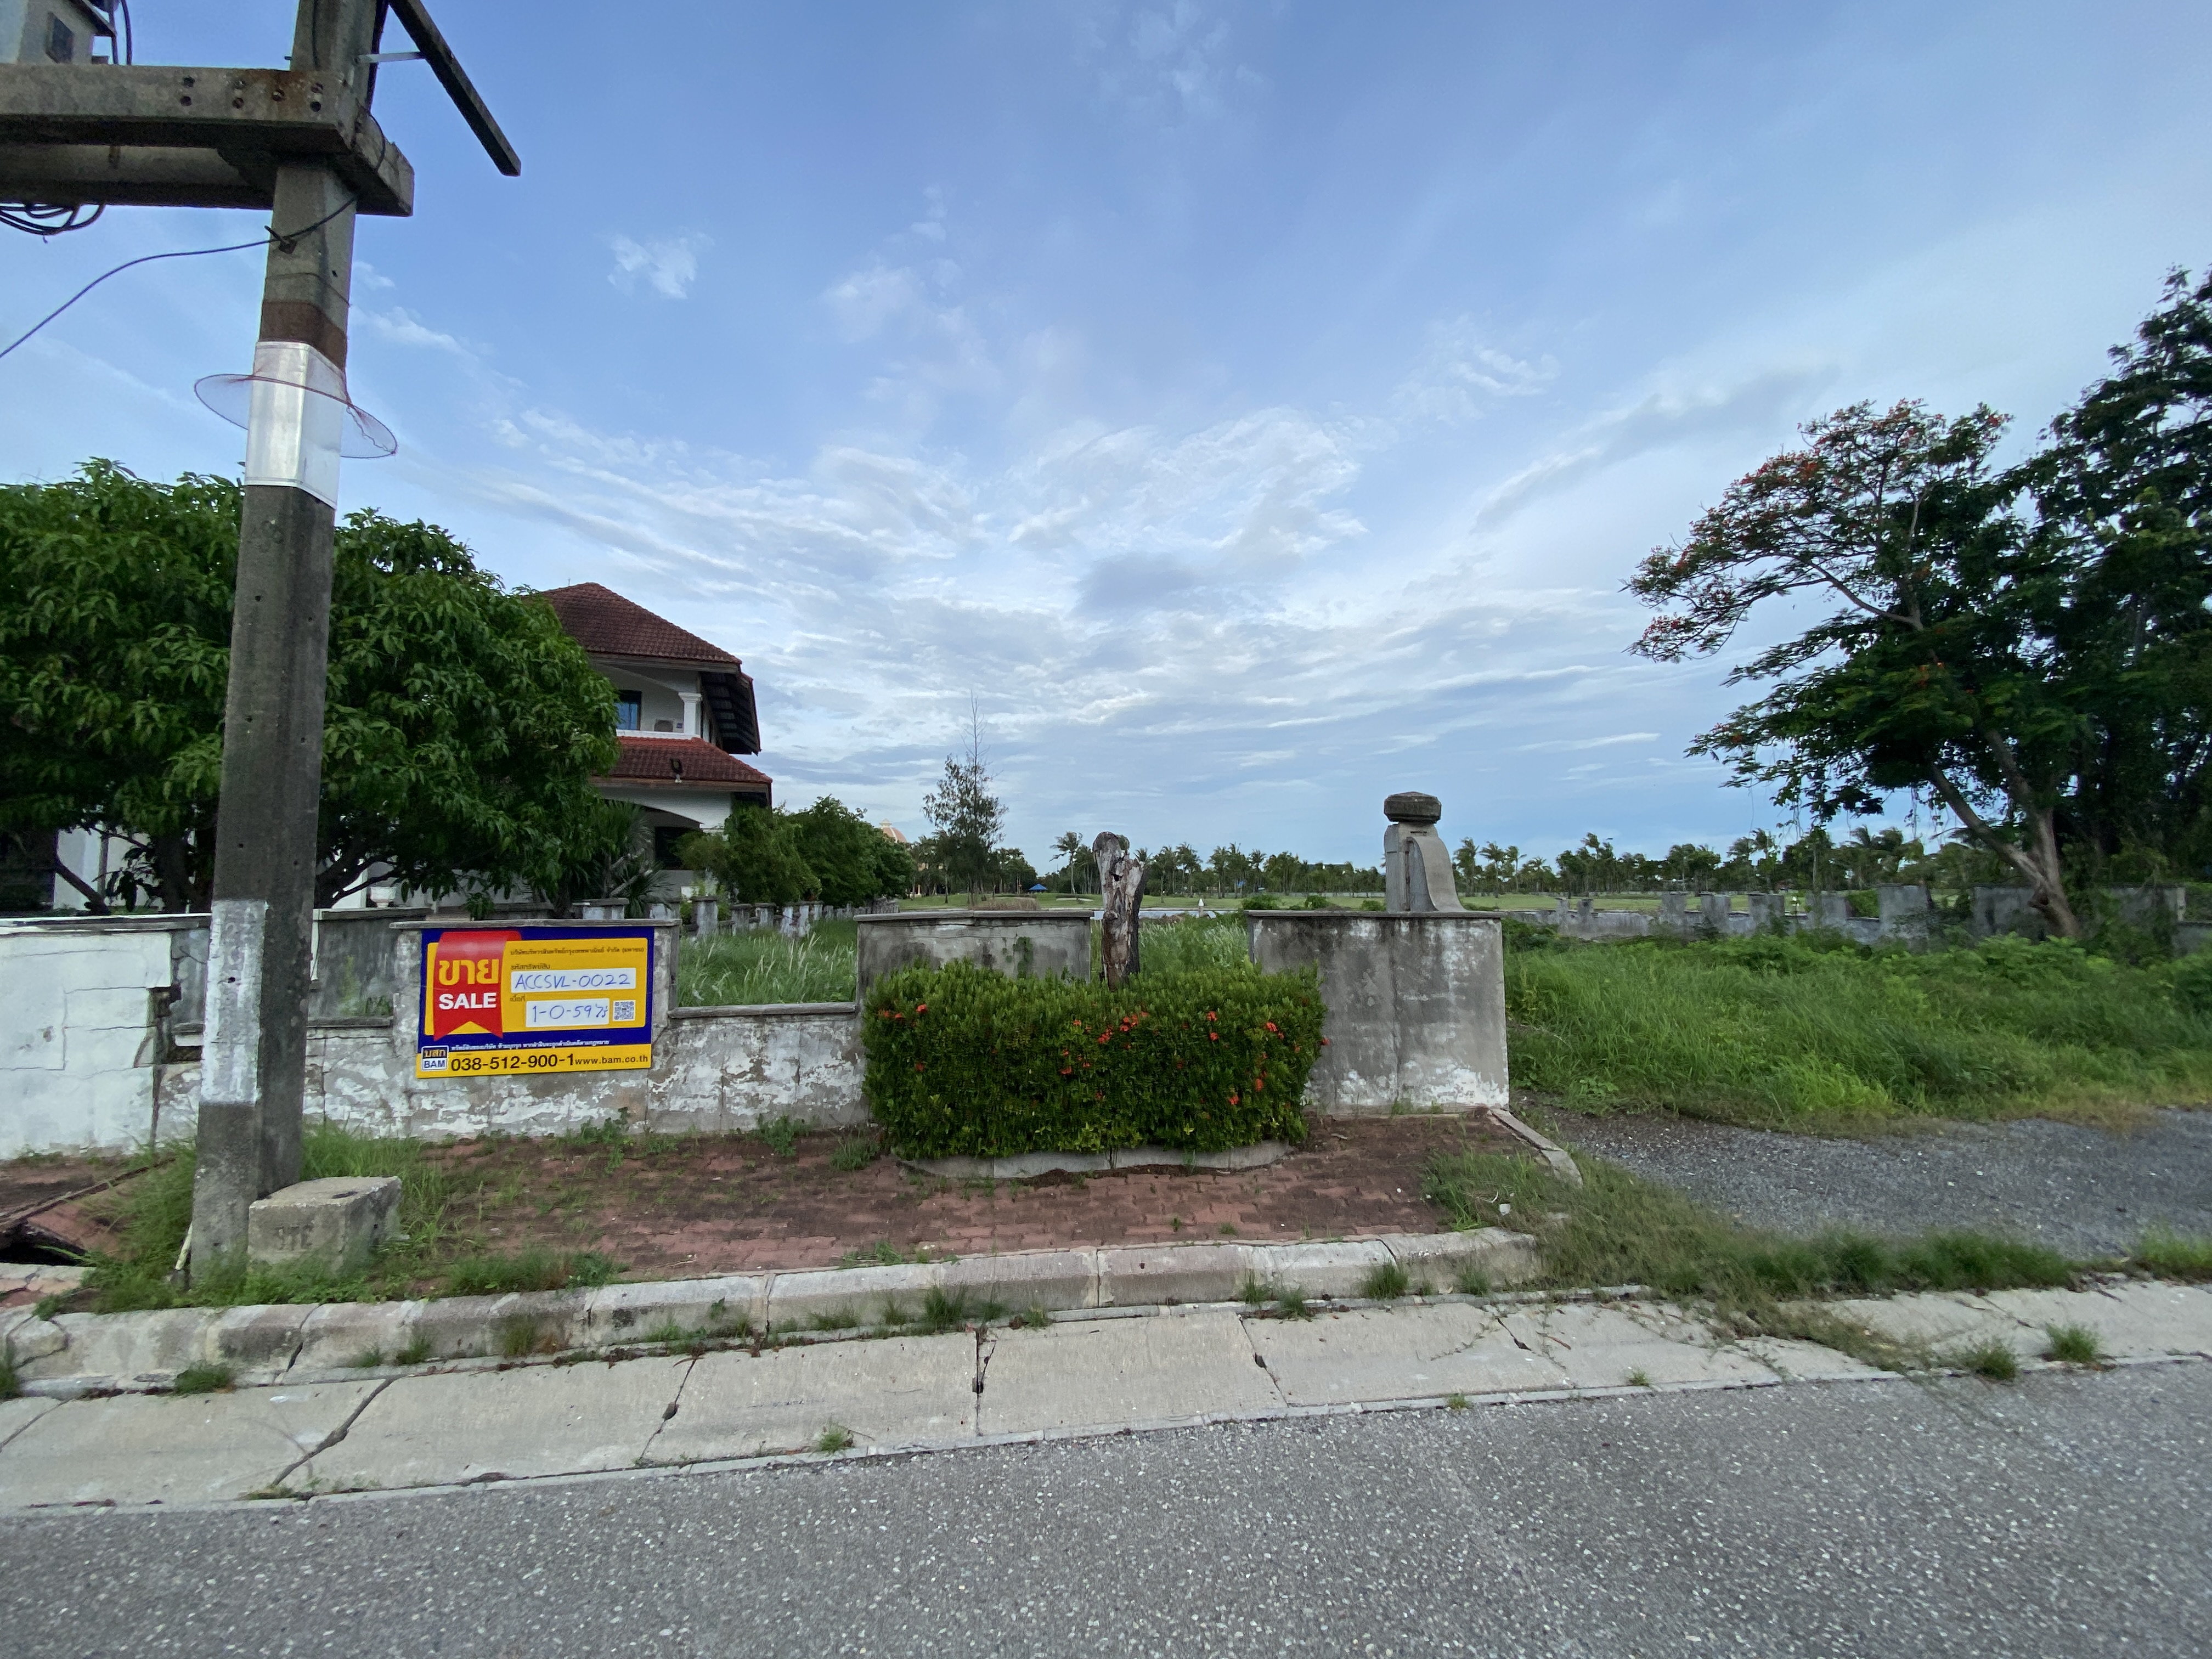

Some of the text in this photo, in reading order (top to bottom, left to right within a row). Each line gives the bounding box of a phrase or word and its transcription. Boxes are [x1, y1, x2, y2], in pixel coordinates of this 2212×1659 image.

[439, 959, 499, 985] ขาย
[515, 974, 630, 989] ACCSVL-0022
[439, 992, 496, 1009] SALE
[424, 1059, 445, 1068] BAM
[451, 1053, 648, 1071] 038-512-900-1 www.bam.co.th
